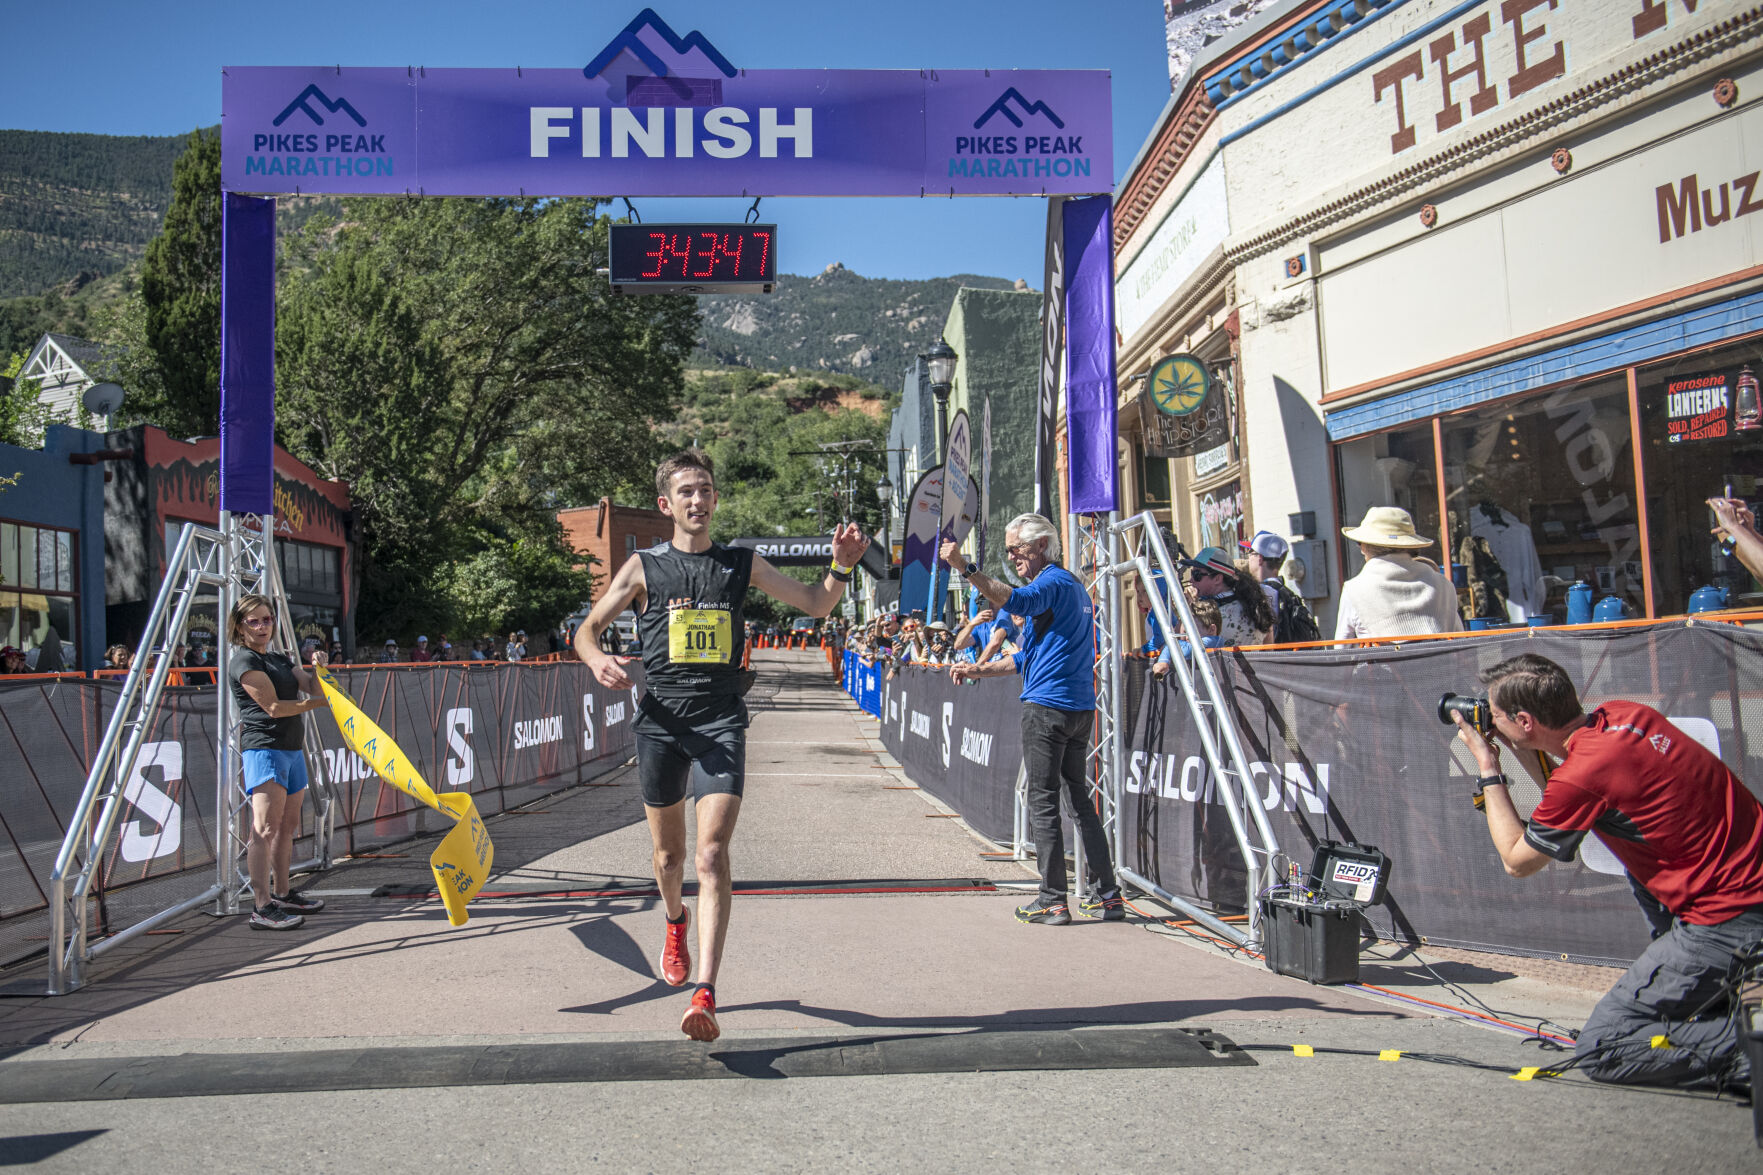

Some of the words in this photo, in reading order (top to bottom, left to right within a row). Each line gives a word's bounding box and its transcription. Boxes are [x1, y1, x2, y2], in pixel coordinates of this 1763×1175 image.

[1372, 0, 1565, 155] THE
[253, 134, 318, 153] PIKES
[326, 135, 385, 153] PEAK
[530, 106, 813, 159] FINISH
[955, 136, 1018, 155] PIKES
[1025, 136, 1083, 155] PEAK
[245, 156, 394, 177] MARATHON
[948, 158, 1091, 178] MARATHON
[1655, 170, 1763, 244] Muz
[642, 232, 770, 277] 3:43:47
[1667, 386, 1729, 418] LANTERNS
[1668, 375, 1726, 396] Kerosene
[1690, 406, 1728, 432] REPAIRED
[1690, 419, 1728, 440] RESTORED
[274, 481, 304, 532] itchen
[754, 543, 834, 557] SALOMO
[685, 631, 717, 650] 101
[514, 715, 563, 750] SALOMON
[583, 693, 594, 751] S
[942, 701, 954, 769] S
[447, 707, 474, 786] S
[960, 727, 993, 767] SALOMON
[118, 741, 183, 863] S
[1337, 864, 1368, 877] RFID
